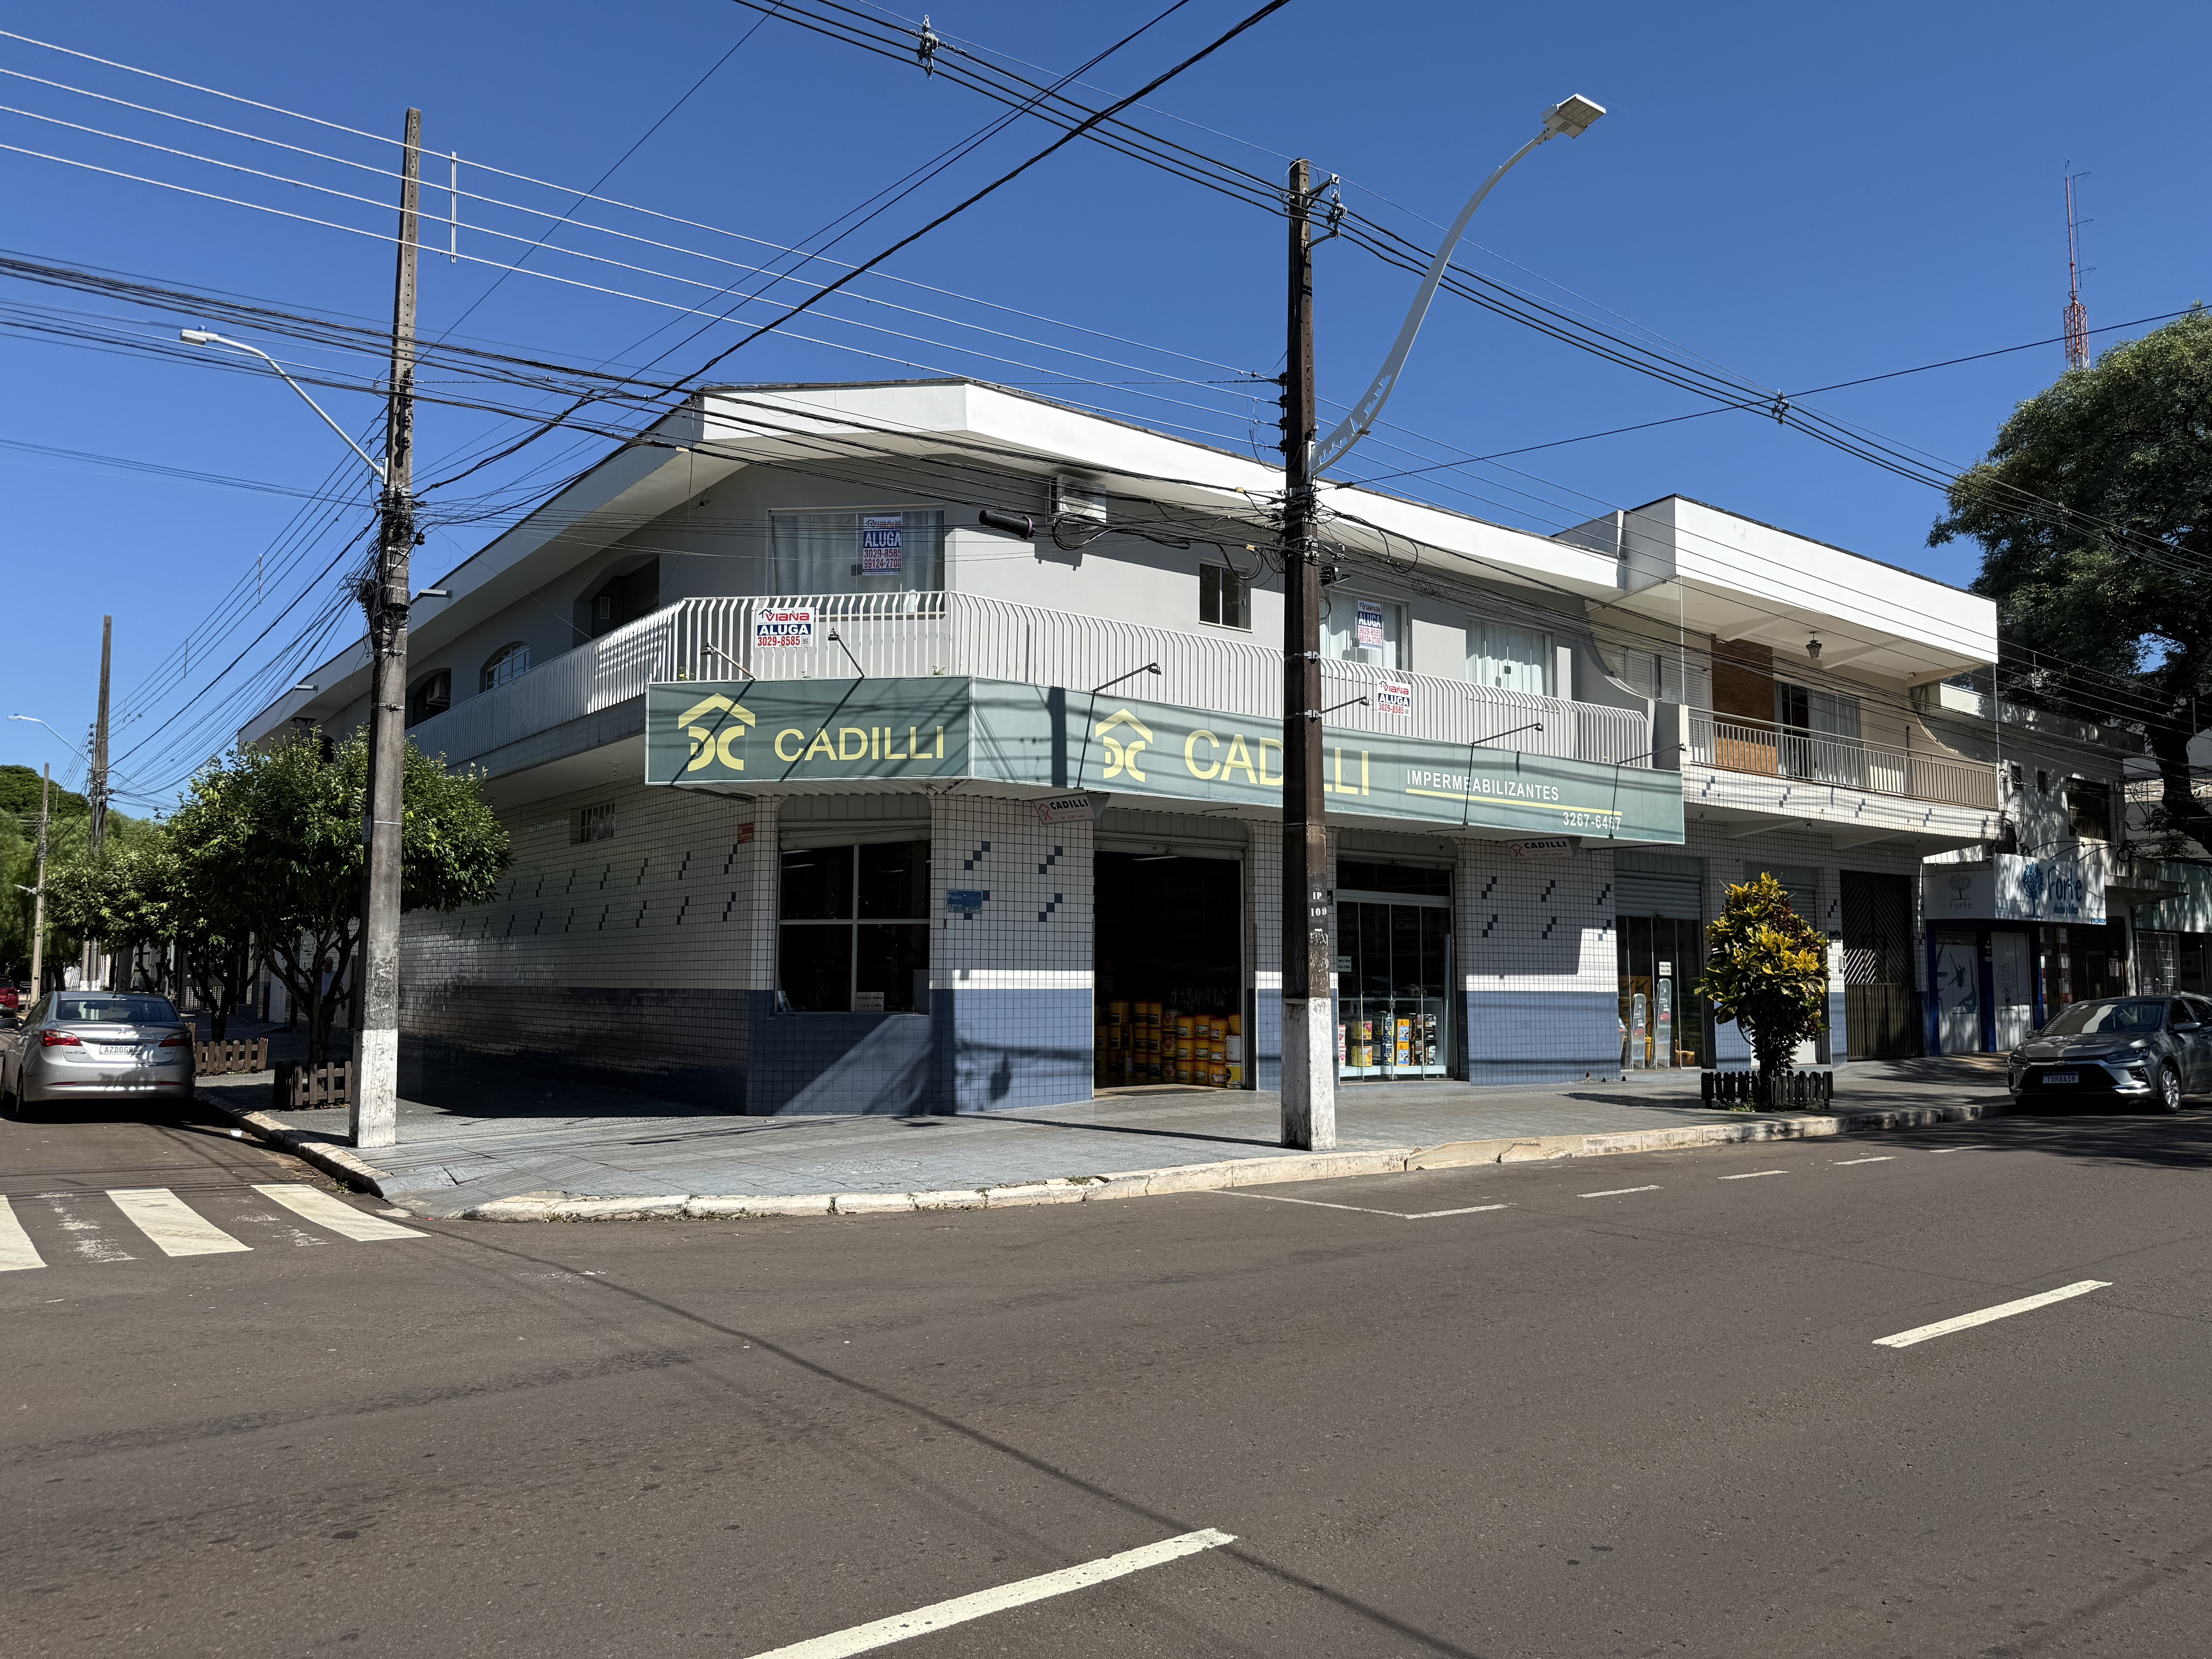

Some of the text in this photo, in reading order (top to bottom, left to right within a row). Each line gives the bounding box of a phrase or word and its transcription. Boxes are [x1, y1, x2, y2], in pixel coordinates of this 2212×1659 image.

[864, 532, 901, 547] ALUGA
[864, 548, 901, 558] 3029-8585
[864, 558, 901, 568] 99124-2700
[1358, 612, 1381, 628] ALUGA
[759, 624, 809, 635] ALUGA
[757, 636, 800, 646] 3029-8585
[1379, 694, 1409, 707] ALUGA
[1378, 703, 1404, 714] 3029-8585
[775, 726, 944, 762] CADILLI
[1184, 729, 1369, 796] CADLI
[1407, 769, 1559, 801] IMPERMEABILIZANTES
[1050, 799, 1089, 810] CADILLI
[1563, 811, 1621, 830] 3267-6467
[1524, 841, 1567, 849] CADILLI
[2047, 866, 2082, 902] Forte
[1950, 900, 1972, 909] Forte
